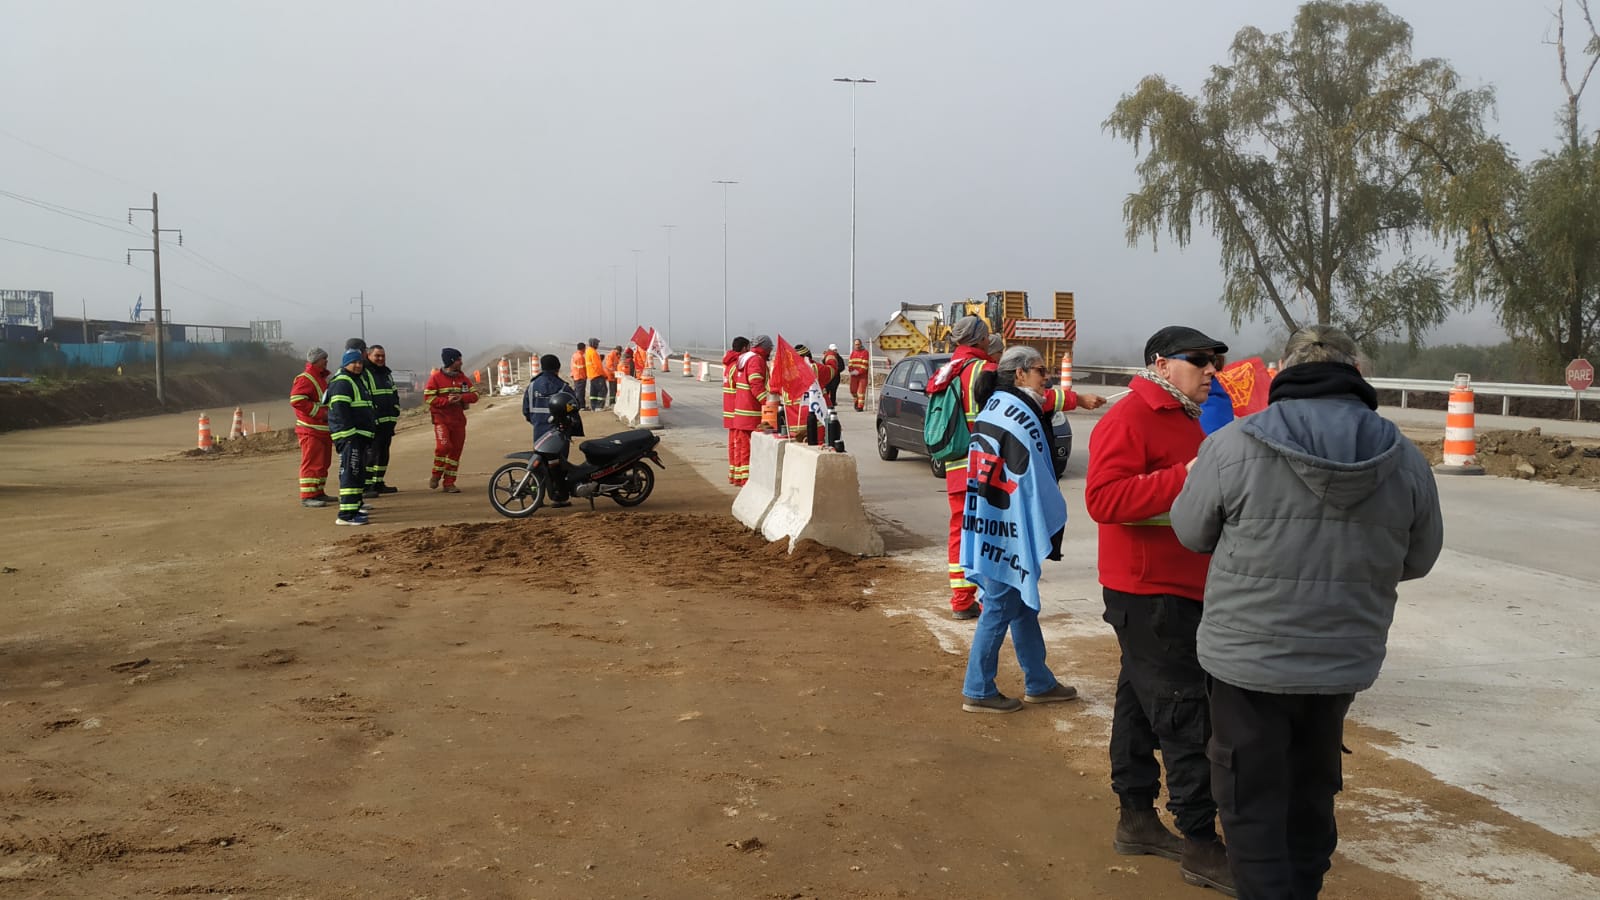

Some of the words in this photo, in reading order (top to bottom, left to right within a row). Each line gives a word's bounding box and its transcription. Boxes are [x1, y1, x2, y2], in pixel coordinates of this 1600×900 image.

[1568, 369, 1591, 381] PARE
[1004, 404, 1043, 453] UNICO
[981, 541, 1030, 584] PIT-CT
